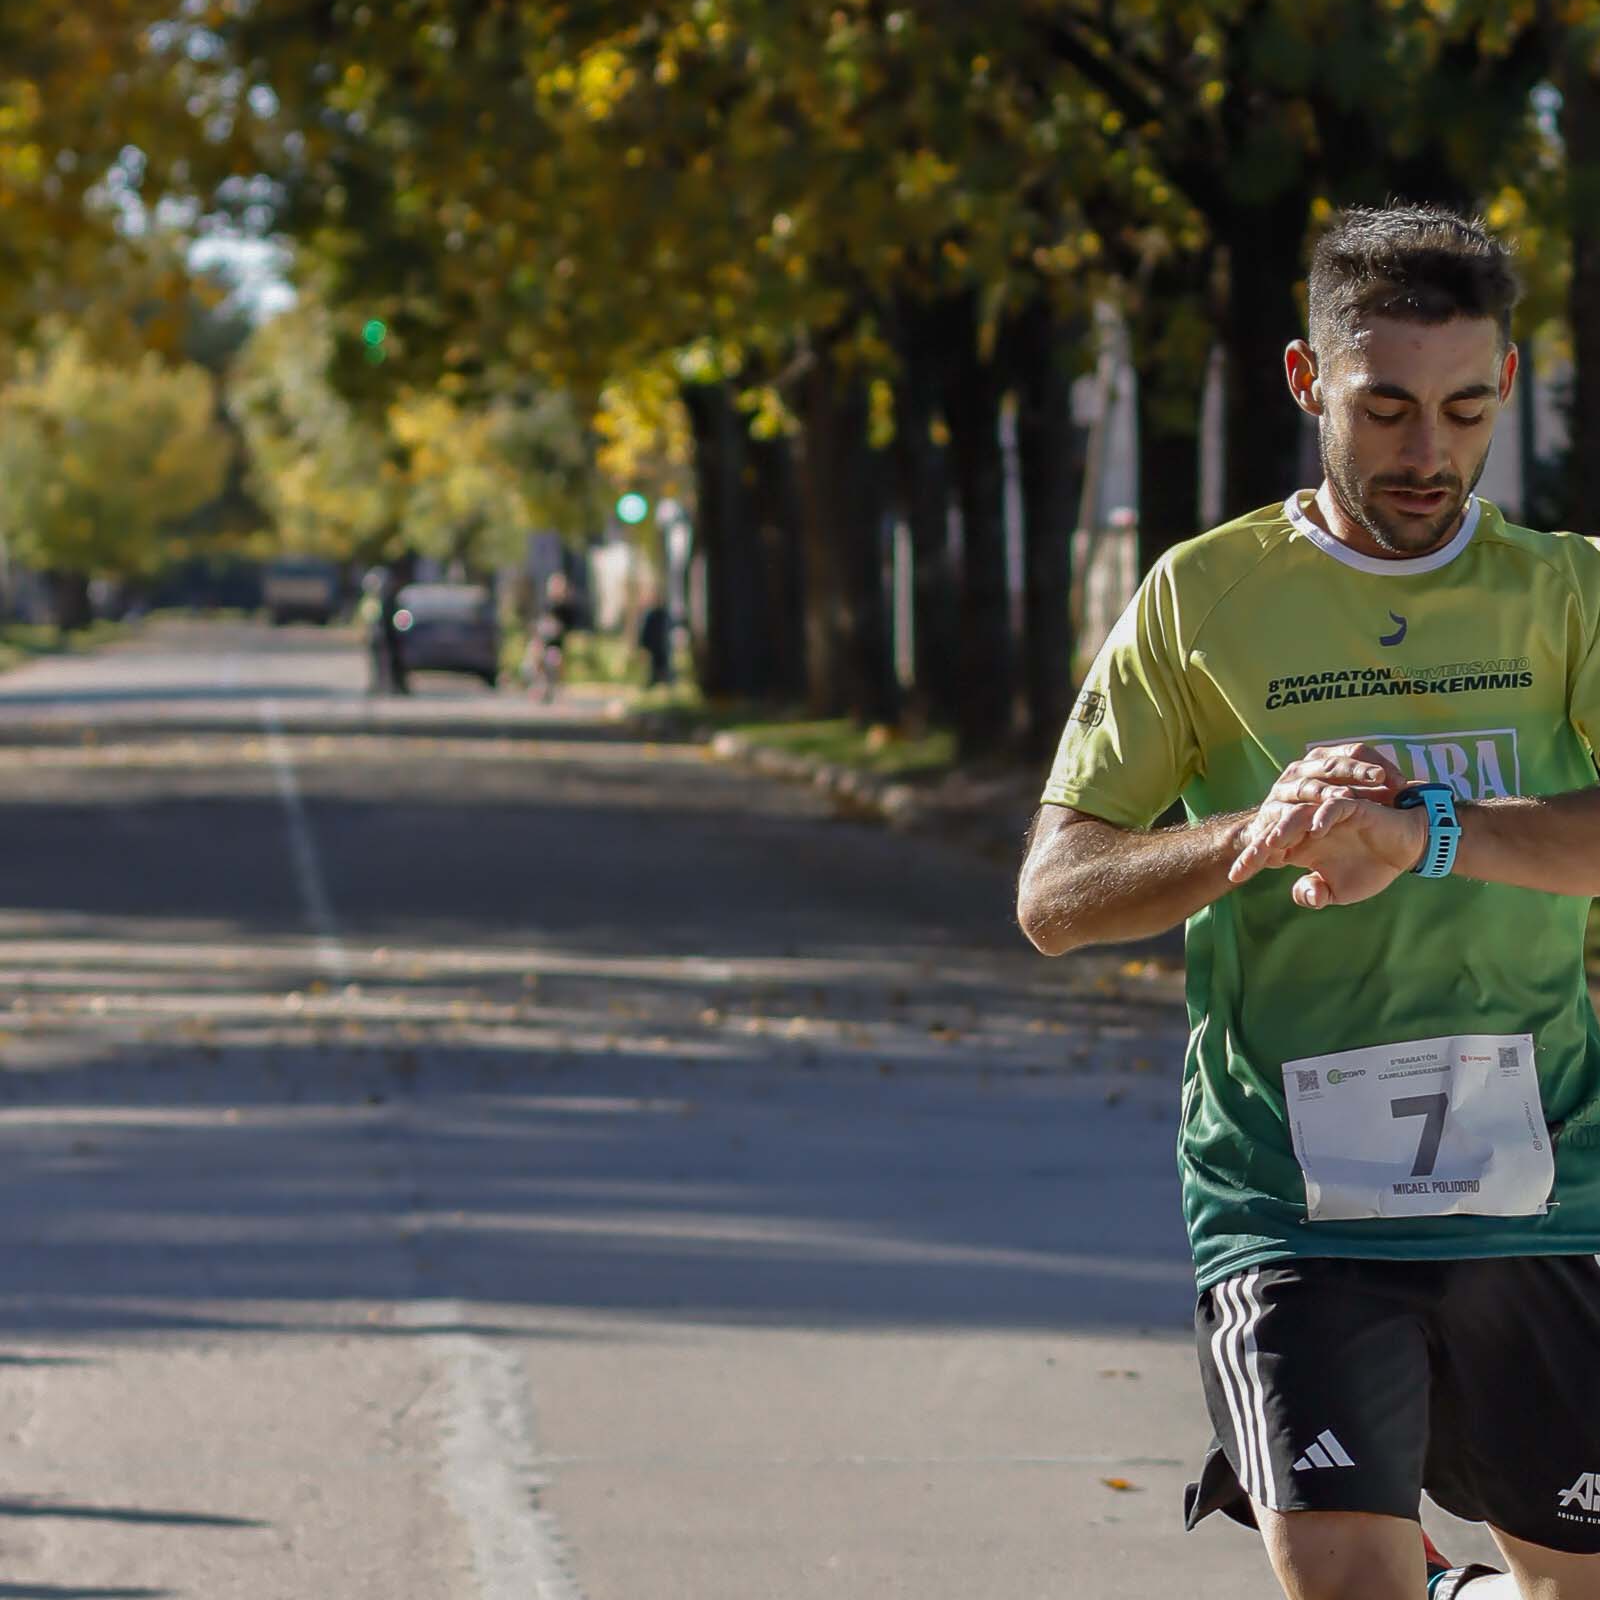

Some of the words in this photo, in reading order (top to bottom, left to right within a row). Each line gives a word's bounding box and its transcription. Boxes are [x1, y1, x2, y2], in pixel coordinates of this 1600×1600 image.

[1265, 672, 1533, 710] CAWILLIAMSKEMMIS
[1390, 1092, 1448, 1177] 7
[1392, 1182, 1431, 1195] MICAEL
[1432, 1179, 1480, 1193] POLIDORO
